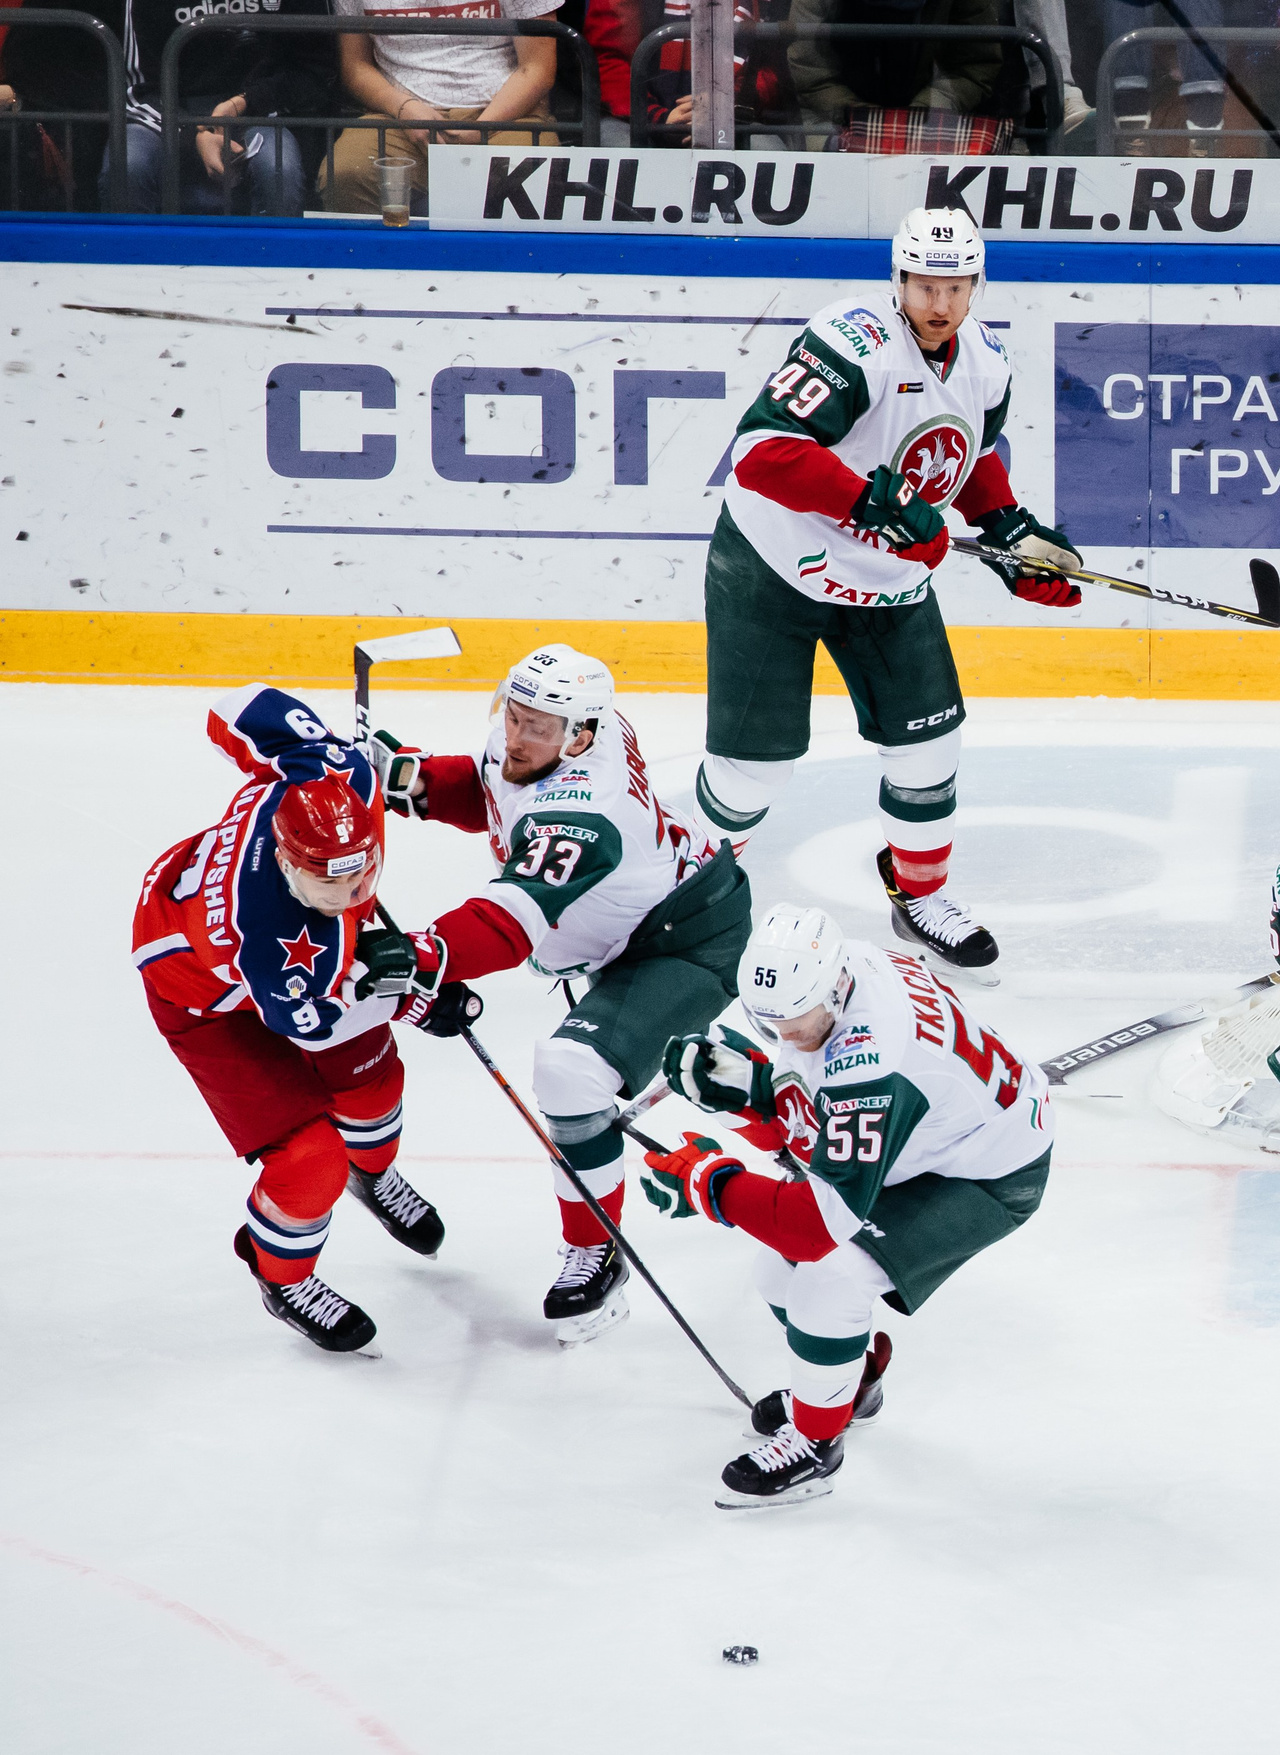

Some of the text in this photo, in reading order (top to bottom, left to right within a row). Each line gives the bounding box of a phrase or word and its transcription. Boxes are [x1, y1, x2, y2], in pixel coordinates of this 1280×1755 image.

[718, 129, 728, 144] 2
[484, 155, 815, 226] KHL.RU
[924, 164, 1254, 233] KHL.RU
[931, 226, 954, 240] 49
[926, 252, 960, 260] СОГАЗ
[826, 318, 872, 358] KAZAN
[799, 348, 849, 390] TATNEFT
[768, 362, 832, 419] 49
[1005, 519, 1028, 542] CCM
[513, 674, 540, 691] СОГАЗ
[906, 704, 958, 731] CCM
[534, 790, 594, 804] KAZAN
[335, 824, 349, 844] 9
[534, 824, 599, 843] TATNEFT
[251, 836, 265, 873] LUTCH
[331, 855, 364, 869] СОГАЗ
[515, 835, 583, 888] 33
[754, 966, 777, 989] 55
[291, 1002, 321, 1035] 9
[1049, 1021, 1158, 1071] BAUER
[824, 1052, 880, 1079] KAZAN
[831, 1094, 892, 1114] TATNEFT
[826, 1112, 885, 1163] 55
